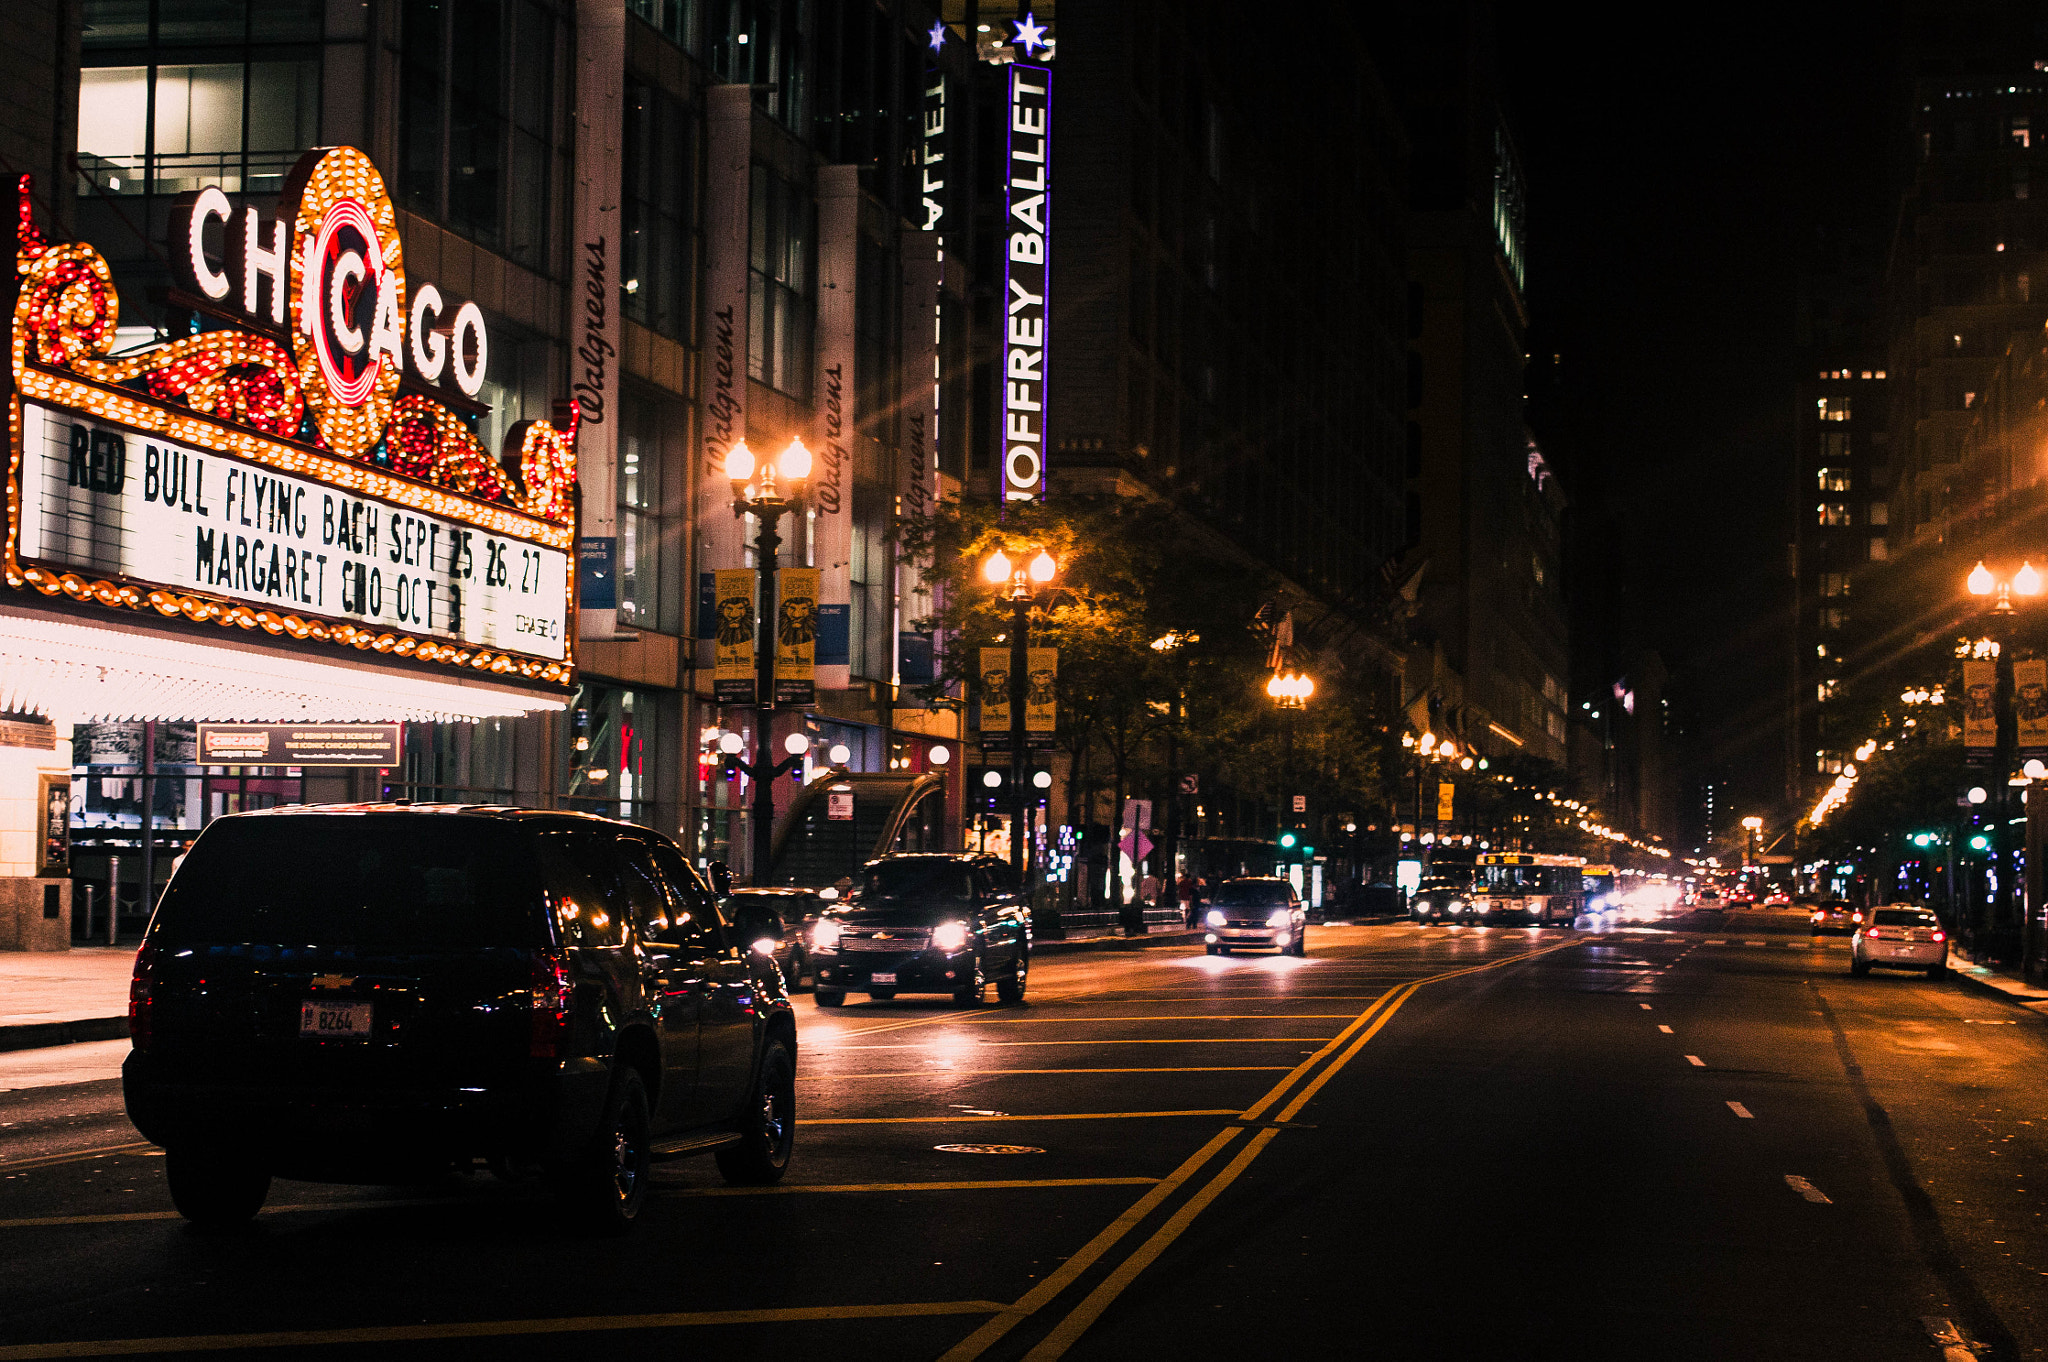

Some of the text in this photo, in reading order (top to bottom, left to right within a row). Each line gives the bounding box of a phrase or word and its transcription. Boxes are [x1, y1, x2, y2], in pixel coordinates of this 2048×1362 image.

[1009, 71, 1045, 265] BALLET
[189, 185, 488, 396] CHICAGO
[573, 236, 615, 424] Walgreens
[68, 423, 540, 594] RED BULL FLYING BACH SEPT 25, 26, 27
[815, 363, 849, 517] Walgreens
[196, 526, 461, 633] MARGARET CHO OCT 3
[319, 1011, 352, 1030] 8264
